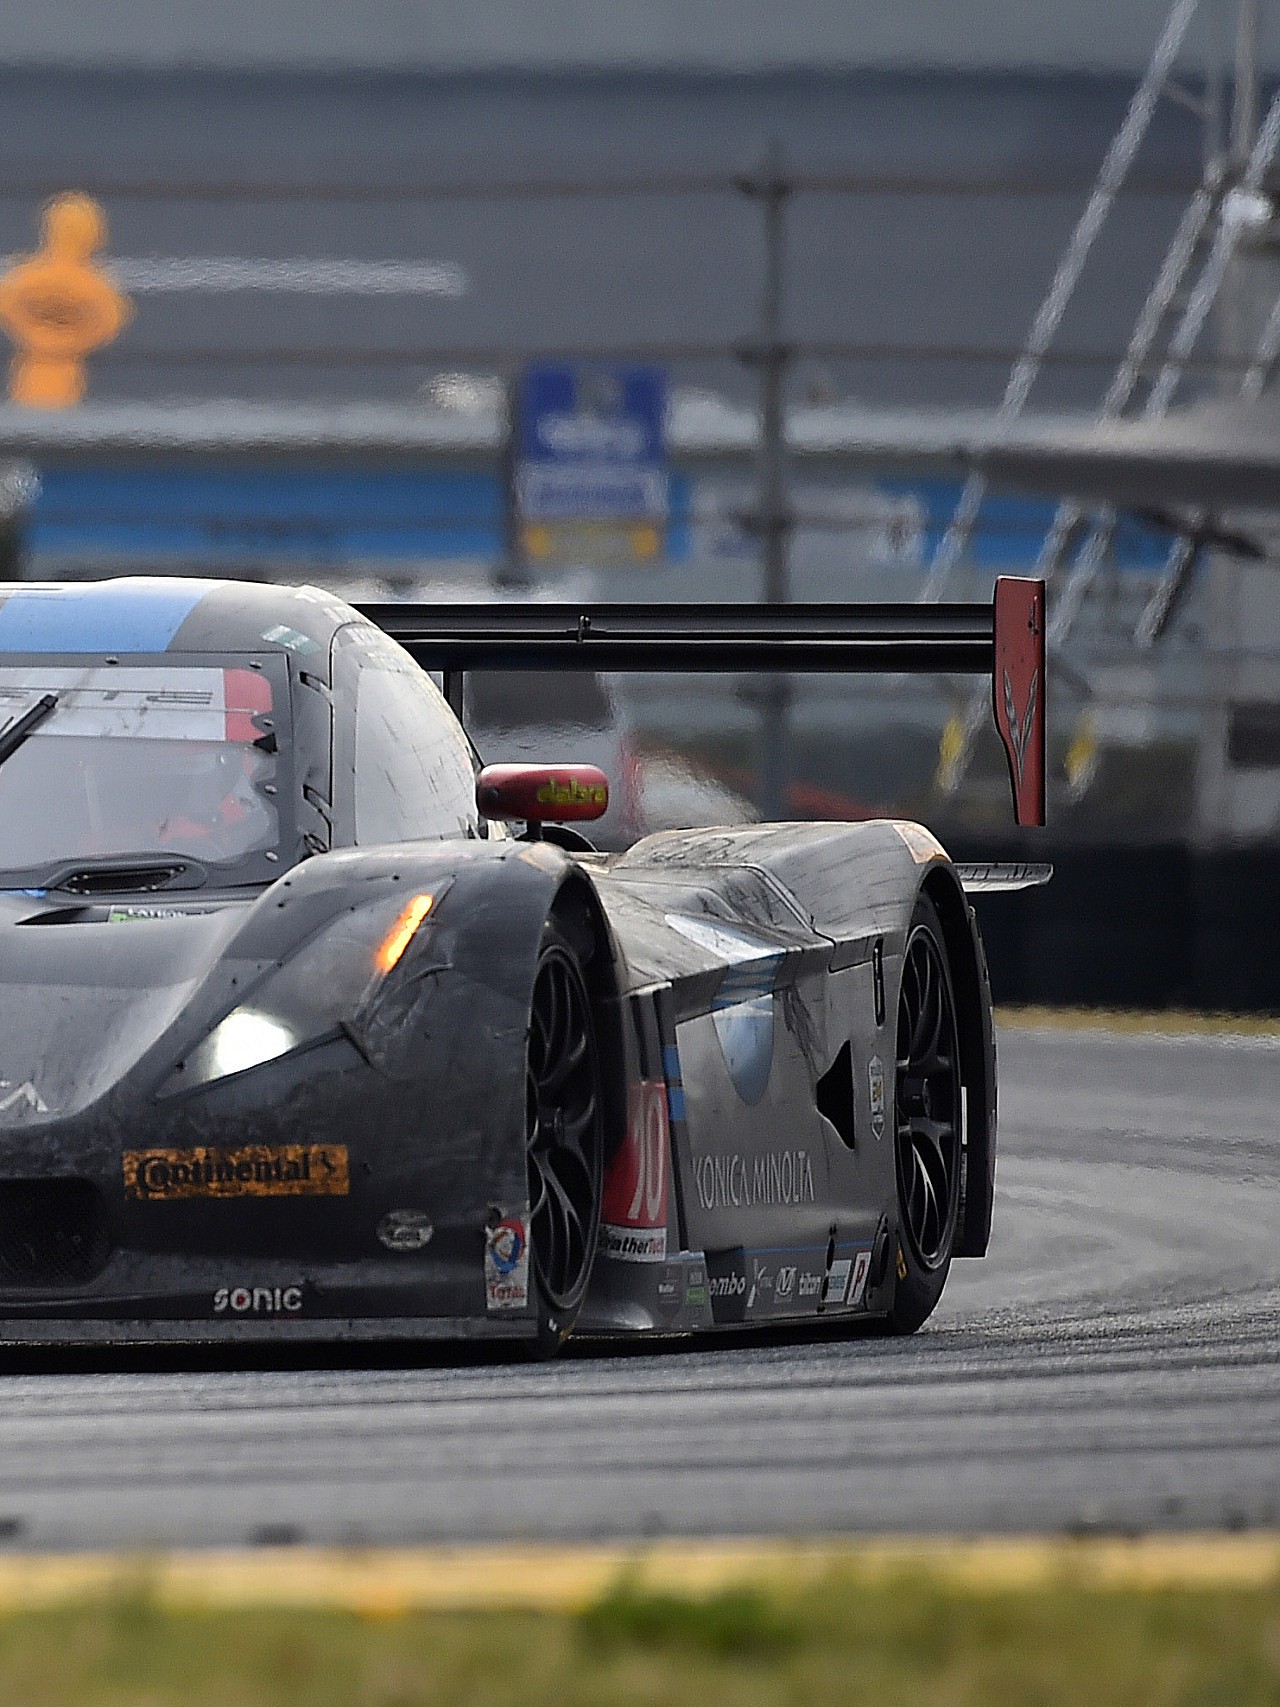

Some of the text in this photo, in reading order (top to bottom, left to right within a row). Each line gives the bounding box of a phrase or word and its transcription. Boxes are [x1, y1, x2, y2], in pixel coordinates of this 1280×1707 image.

[136, 1152, 311, 1193] Continental
[627, 1088, 664, 1221] 10
[692, 1150, 815, 1209] KONICA MINOLTA
